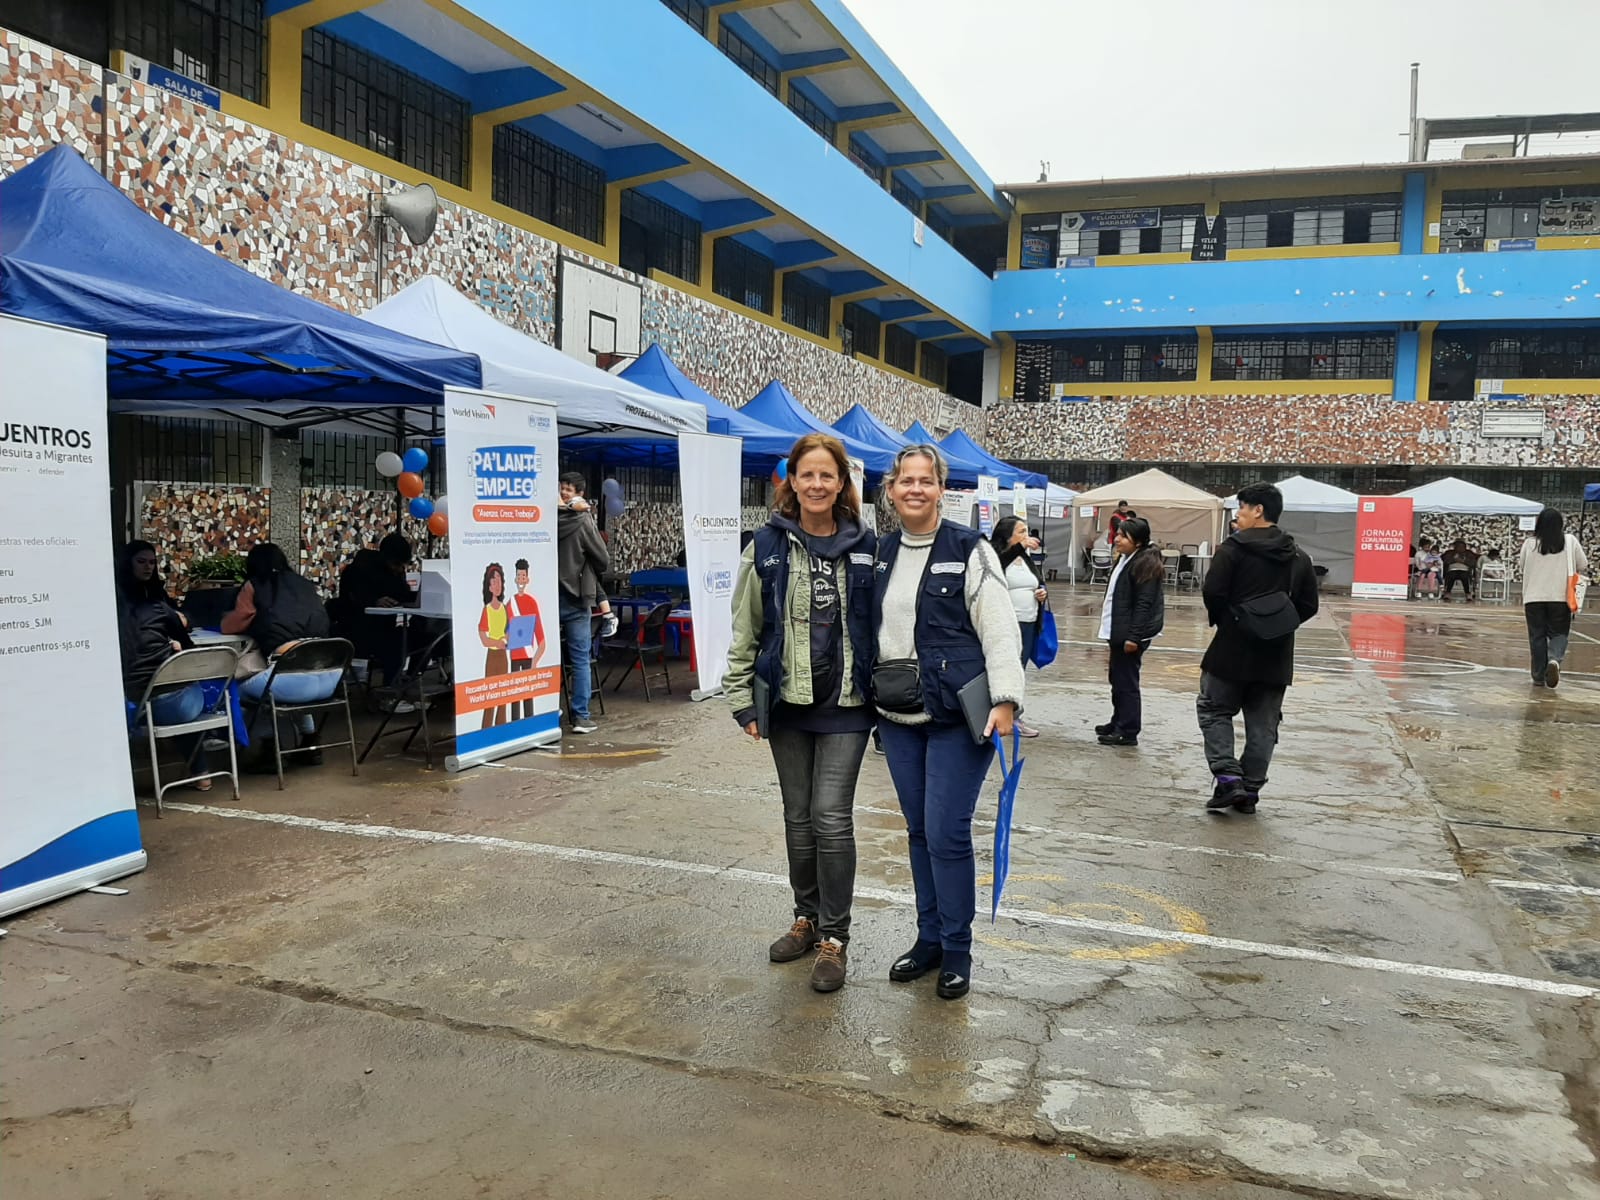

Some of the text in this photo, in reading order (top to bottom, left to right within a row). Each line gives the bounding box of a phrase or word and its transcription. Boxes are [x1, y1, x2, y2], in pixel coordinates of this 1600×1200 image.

[165, 78, 188, 95] SALA
[190, 88, 204, 100] DE
[452, 407, 490, 420] World Vision
[44, 449, 93, 464] Migrantes
[702, 517, 738, 528] ENCUENTROS
[1361, 529, 1404, 538] JORNADA
[24, 536, 44, 546] redes
[1360, 543, 1404, 552] DE SALUD
[470, 694, 486, 704] World
[486, 692, 501, 700] Vision
